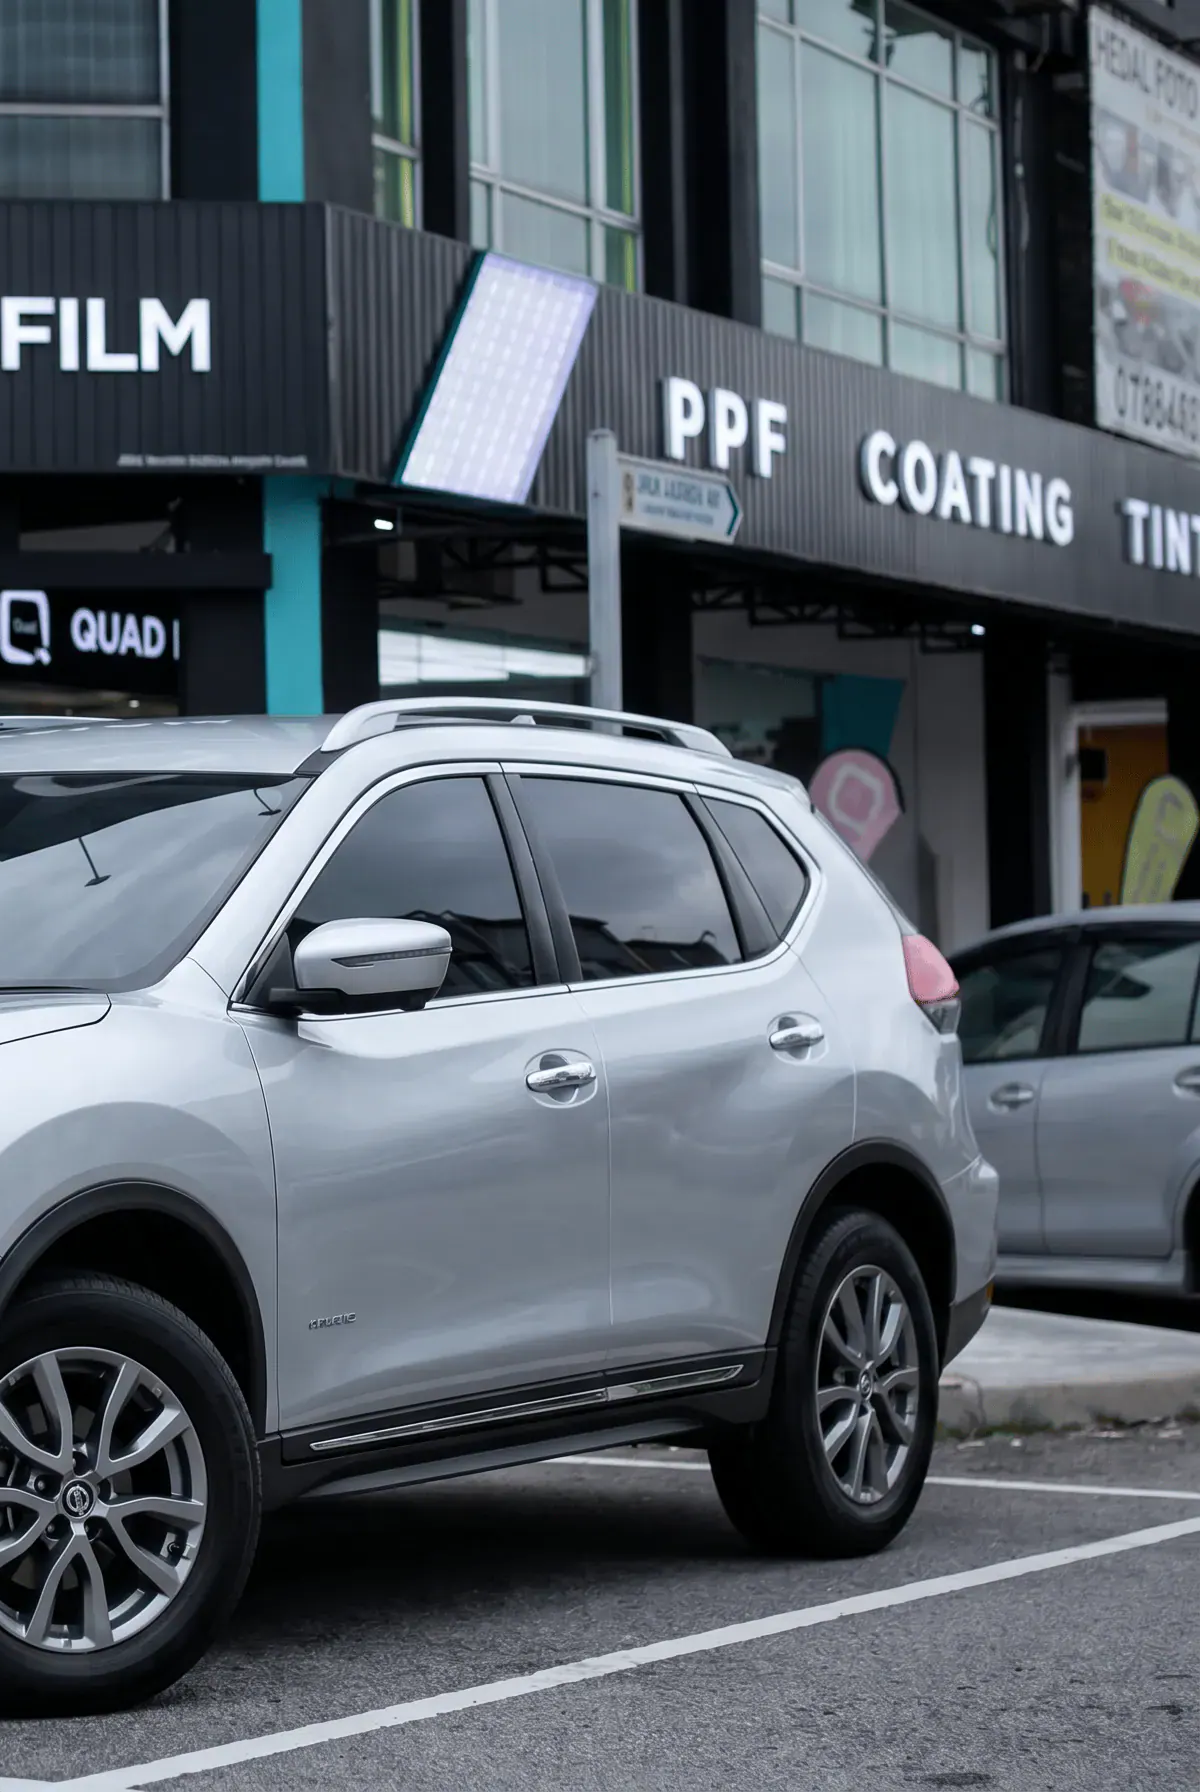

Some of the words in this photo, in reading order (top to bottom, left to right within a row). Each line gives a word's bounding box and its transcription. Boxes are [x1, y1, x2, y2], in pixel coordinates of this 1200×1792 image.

[1, 296, 211, 372] FILM
[663, 376, 787, 479] PPF
[861, 430, 1074, 547] COATING
[71, 607, 166, 659] QUAD
